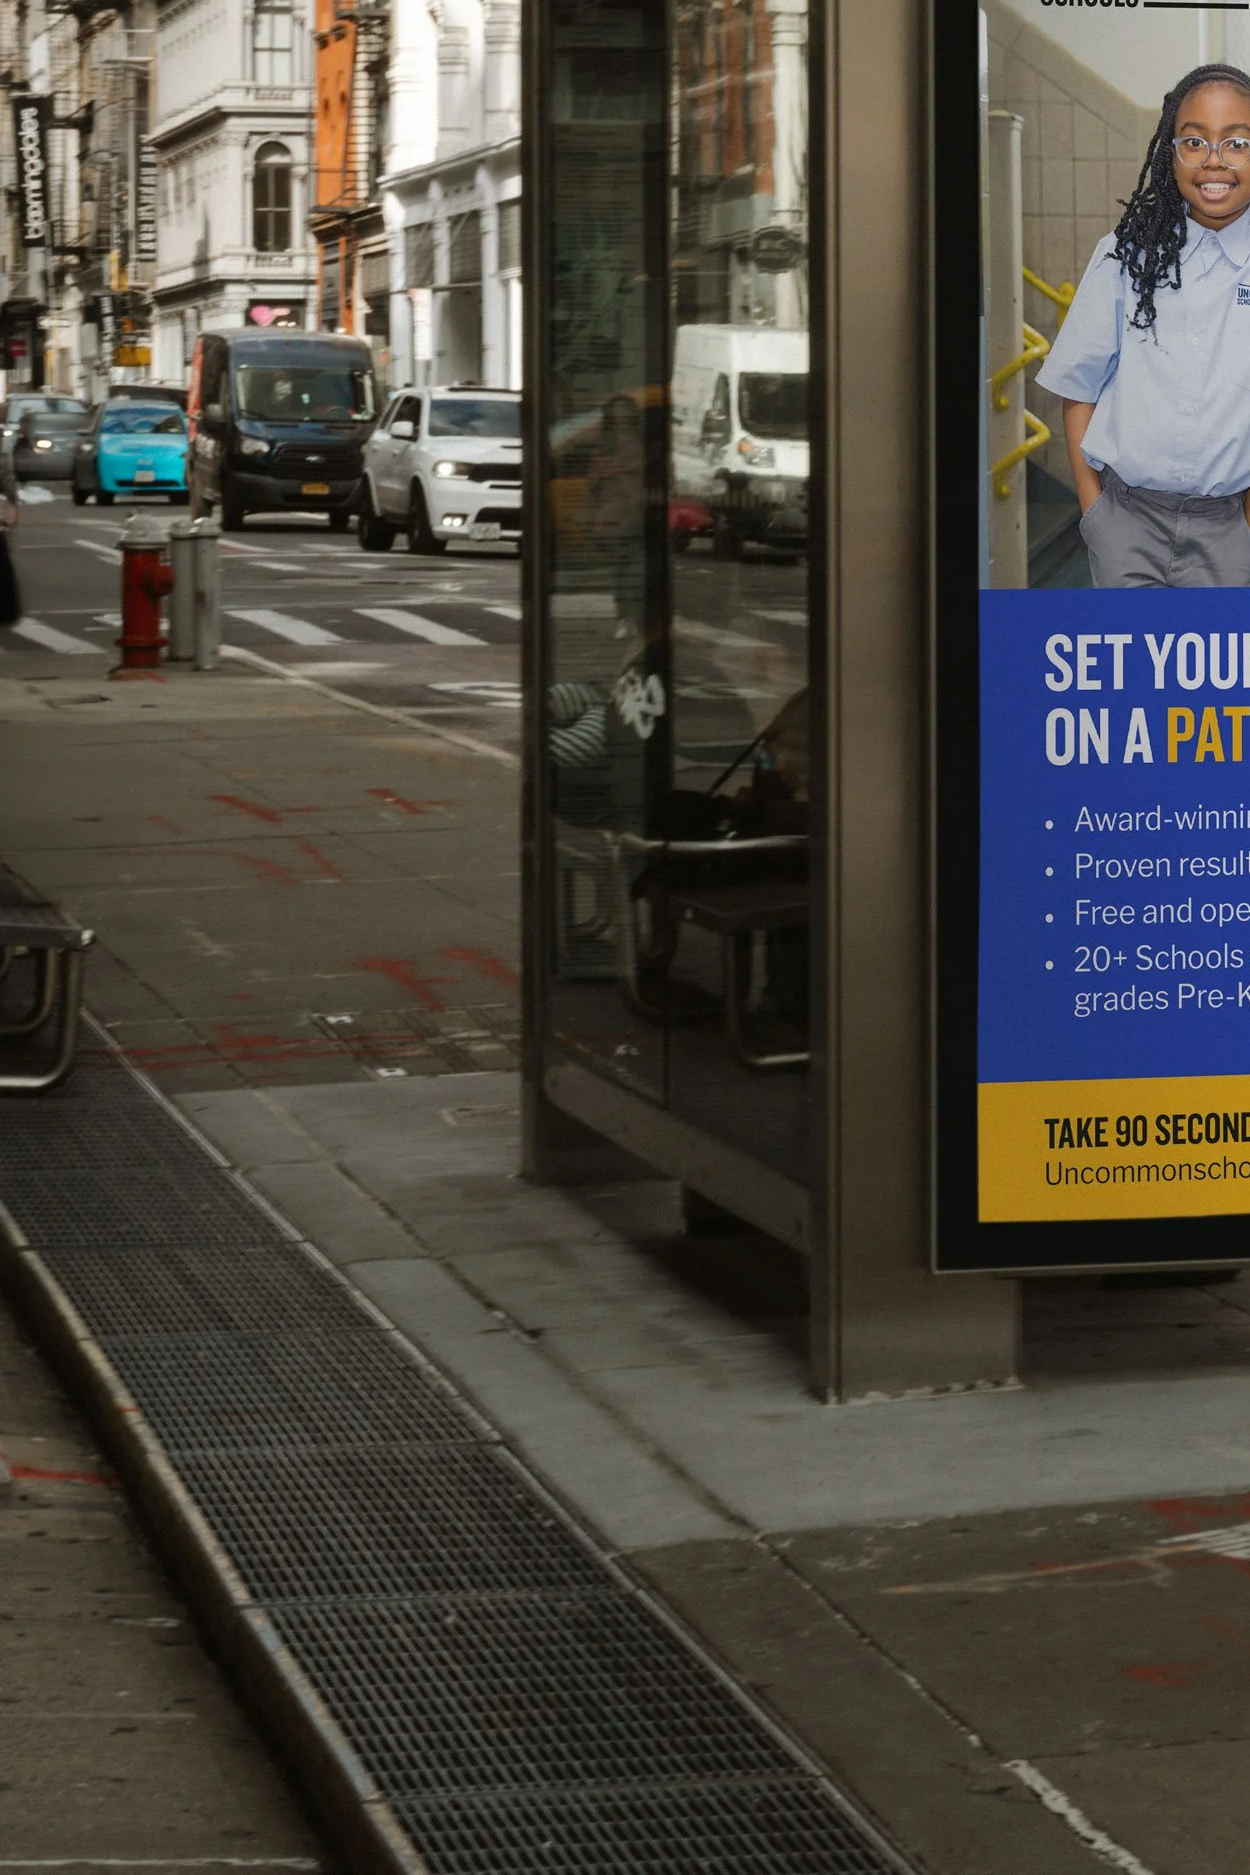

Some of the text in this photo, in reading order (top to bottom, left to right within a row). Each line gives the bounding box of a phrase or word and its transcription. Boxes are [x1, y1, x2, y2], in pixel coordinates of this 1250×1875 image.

[1044, 633, 1133, 692] SET
[1045, 707, 1109, 766] ON
[1122, 707, 1154, 764] A
[1075, 852, 1171, 879] Proven
[1075, 899, 1136, 926] Free
[1142, 896, 1192, 924] and
[1074, 945, 1128, 973] 20+
[1135, 942, 1244, 971] Schools
[1074, 984, 1169, 1018] grades
[1044, 1116, 1109, 1149] TAKE
[1115, 1114, 1148, 1148] 90
